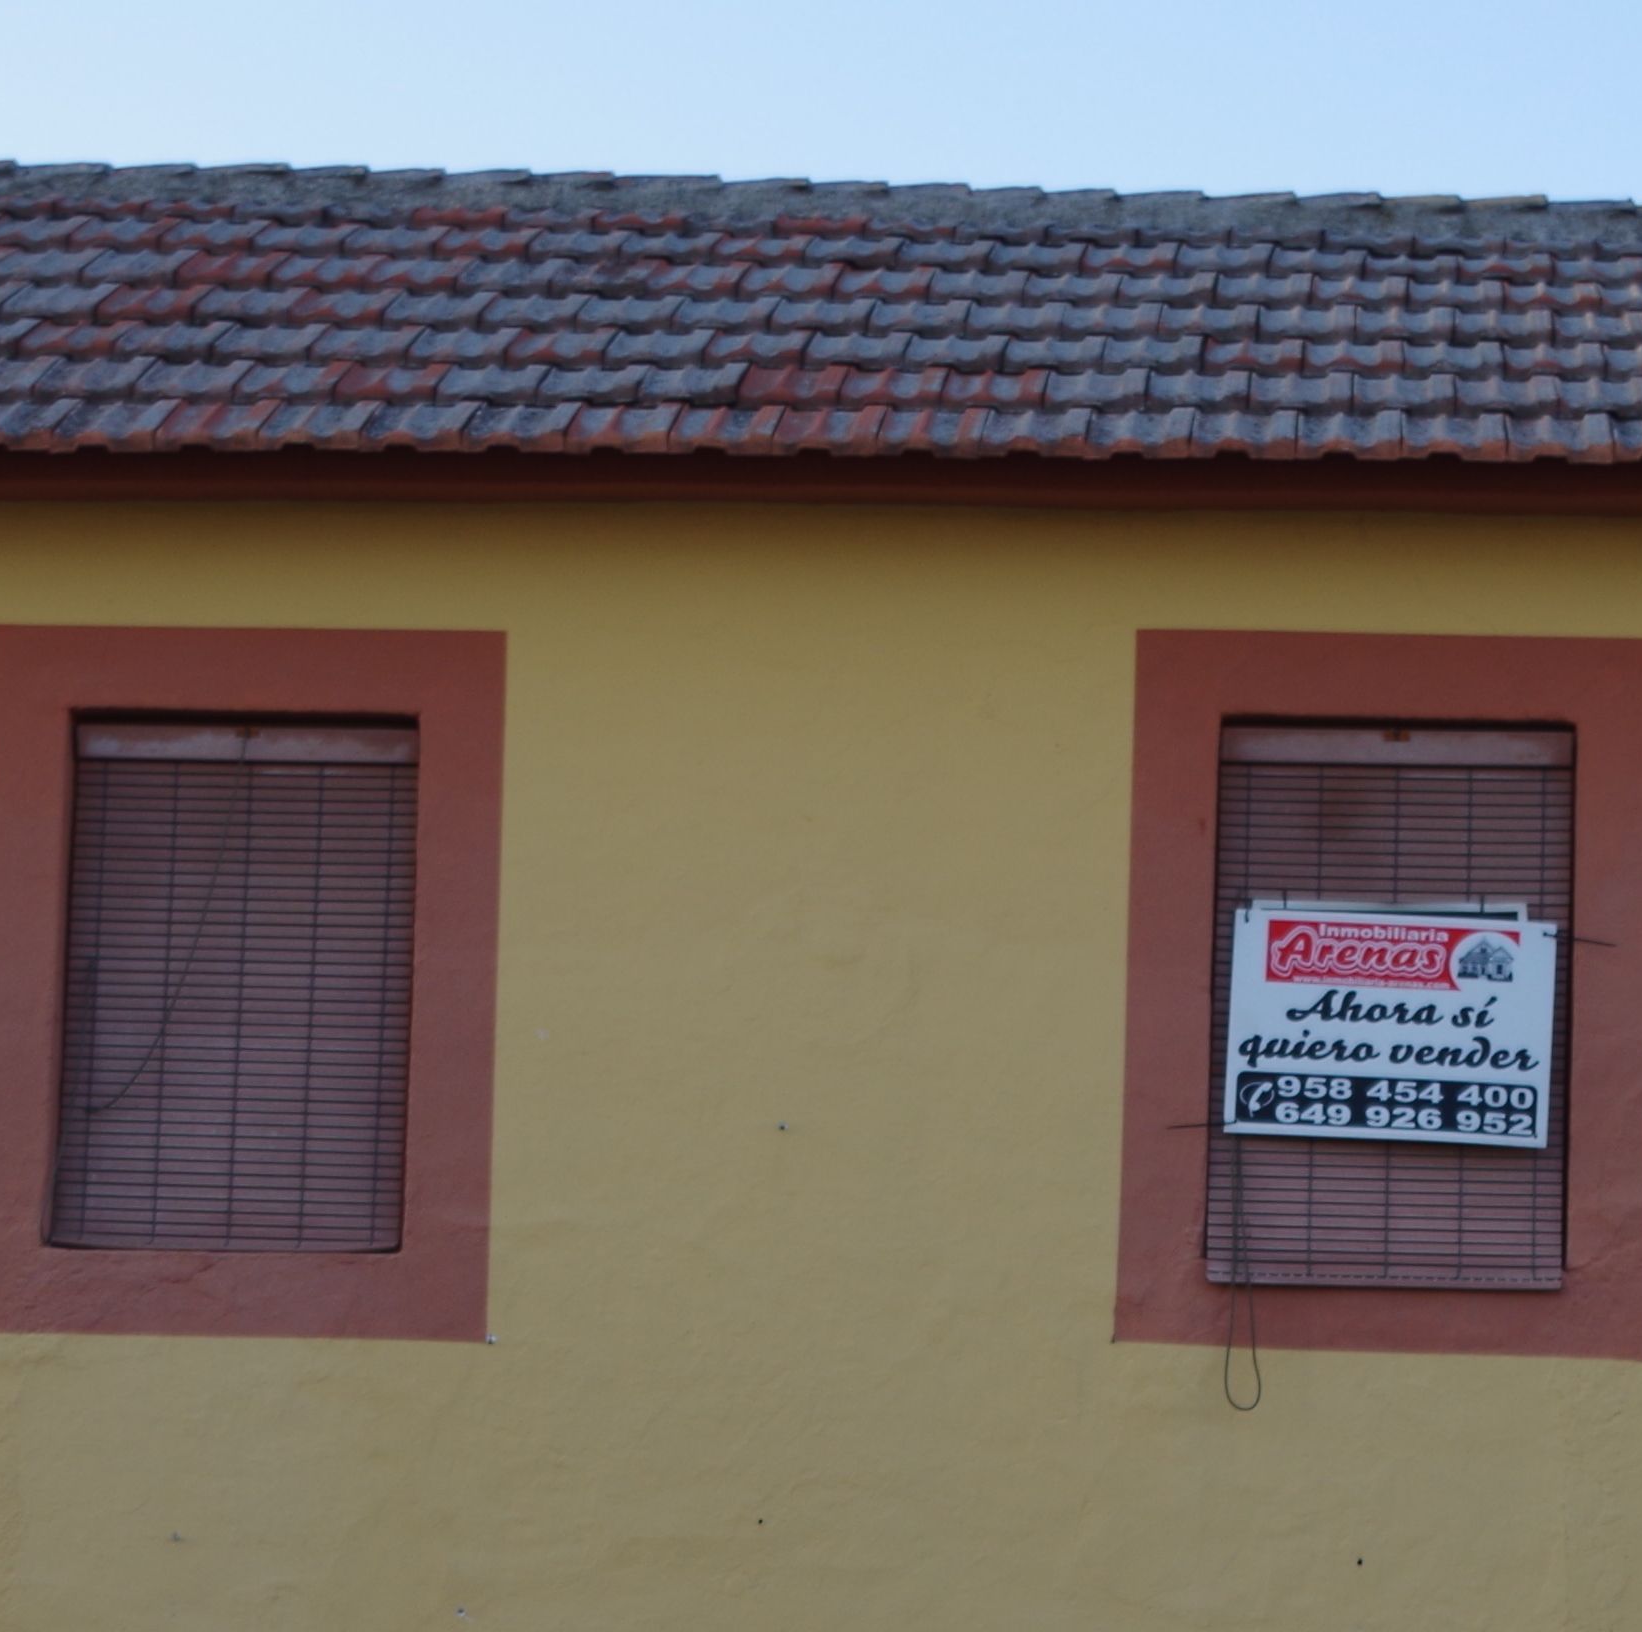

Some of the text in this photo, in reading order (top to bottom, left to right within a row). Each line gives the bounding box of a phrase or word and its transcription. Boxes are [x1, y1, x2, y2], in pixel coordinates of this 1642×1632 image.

[1318, 923, 1450, 943] Inmobiliaria
[1271, 925, 1447, 979] Arenas
[1285, 989, 1498, 1028] Ahora sí
[1238, 1030, 1540, 1072] quiero vender
[1276, 1076, 1535, 1110] 958 454 400
[1274, 1102, 1533, 1136] 649 926 952
